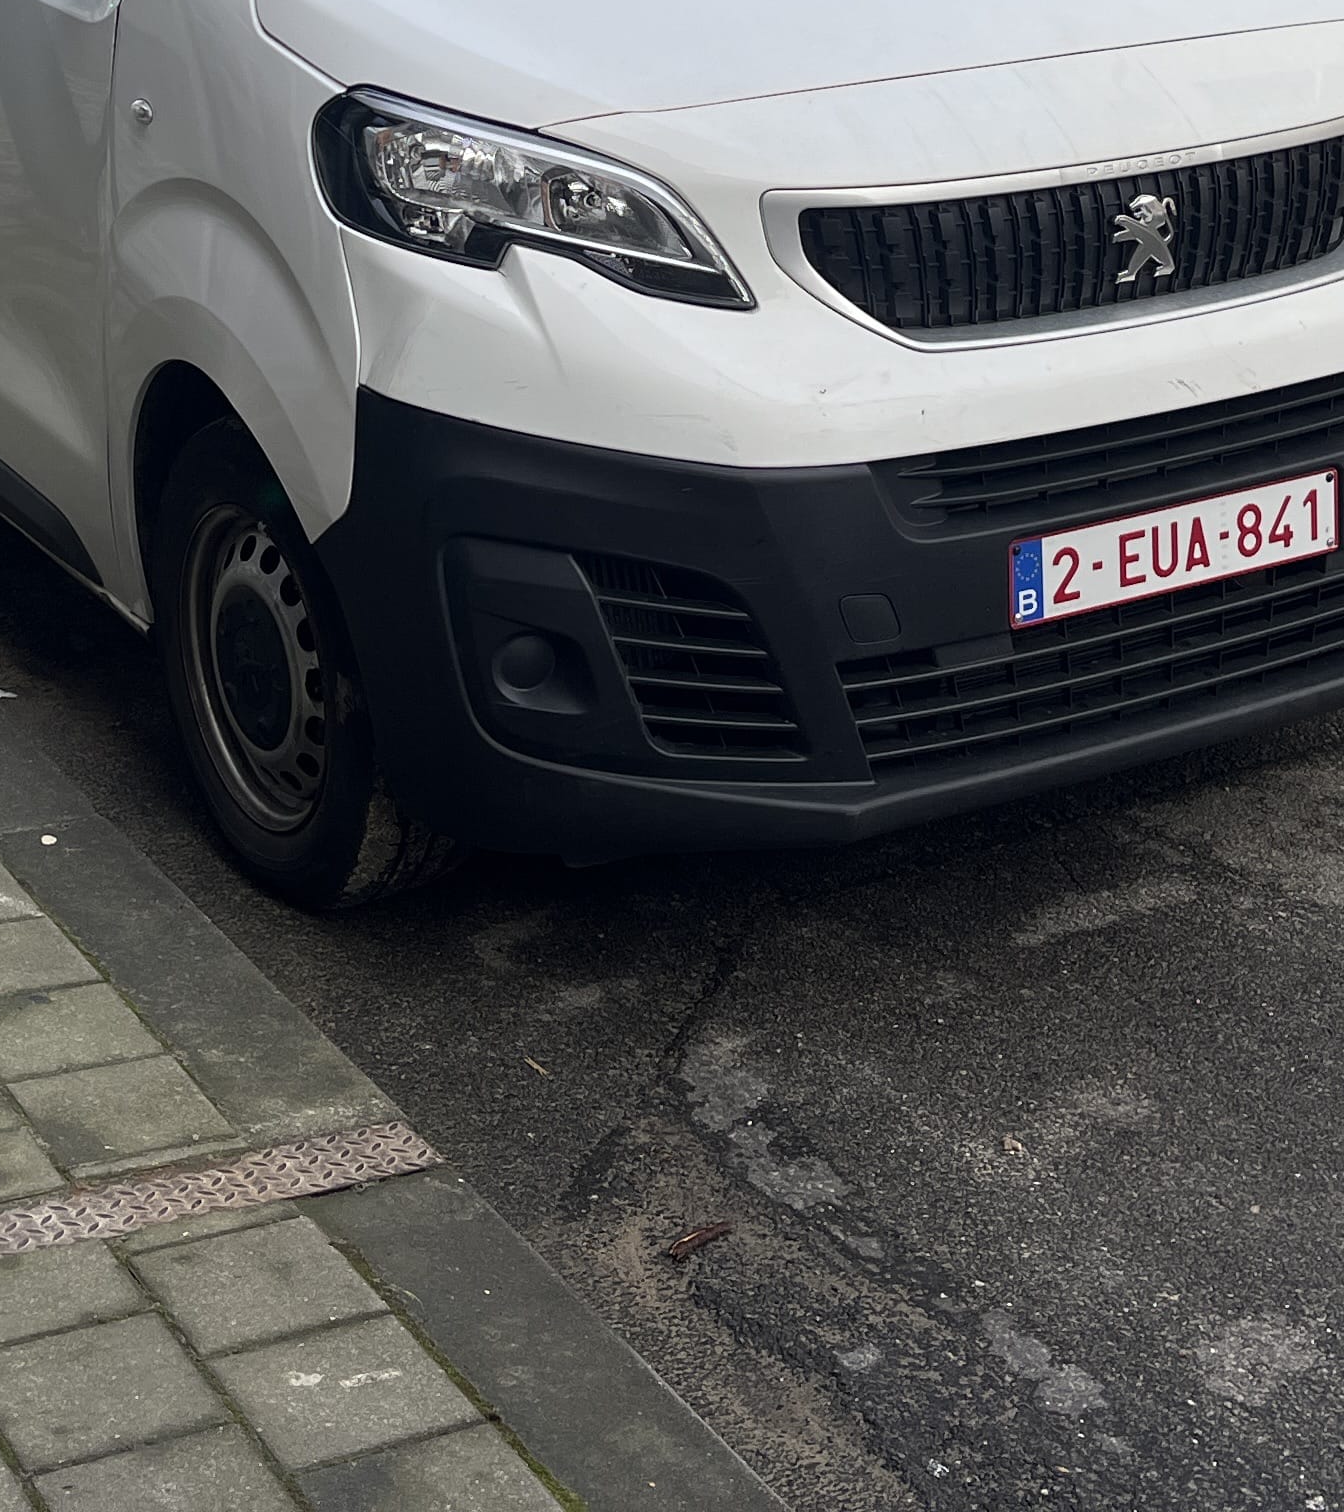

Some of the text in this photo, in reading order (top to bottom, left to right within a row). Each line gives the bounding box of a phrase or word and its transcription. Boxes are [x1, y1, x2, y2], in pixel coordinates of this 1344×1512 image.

[1086, 151, 1196, 176] PEUGEOT
[1018, 489, 1319, 616] B 2-EUA-841
